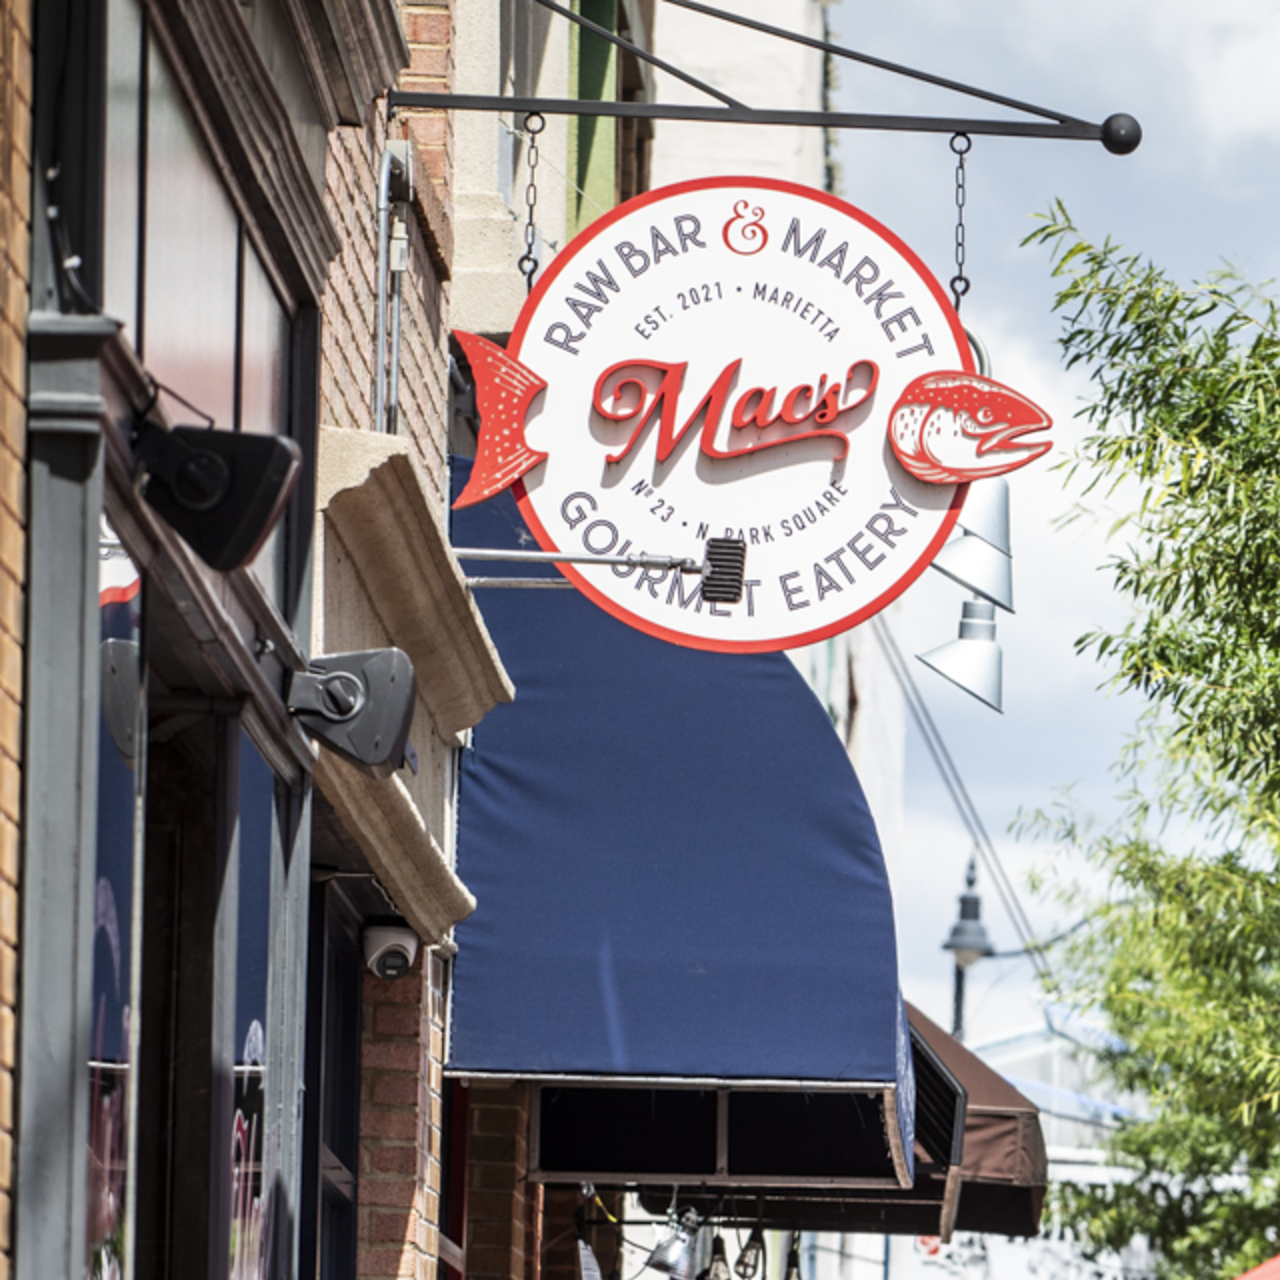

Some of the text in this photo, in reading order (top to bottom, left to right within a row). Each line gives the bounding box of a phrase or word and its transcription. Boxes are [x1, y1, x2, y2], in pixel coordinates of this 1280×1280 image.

[543, 199, 934, 362] RAW BAR & MARKET
[634, 282, 841, 343] EST. 2021 MARIETTA
[592, 358, 880, 465] Mac's
[559, 489, 919, 617] GOURMT EATERY
[649, 498, 675, 523] 23
[725, 525, 776, 546] PARK
[780, 481, 850, 538] SQUARE
